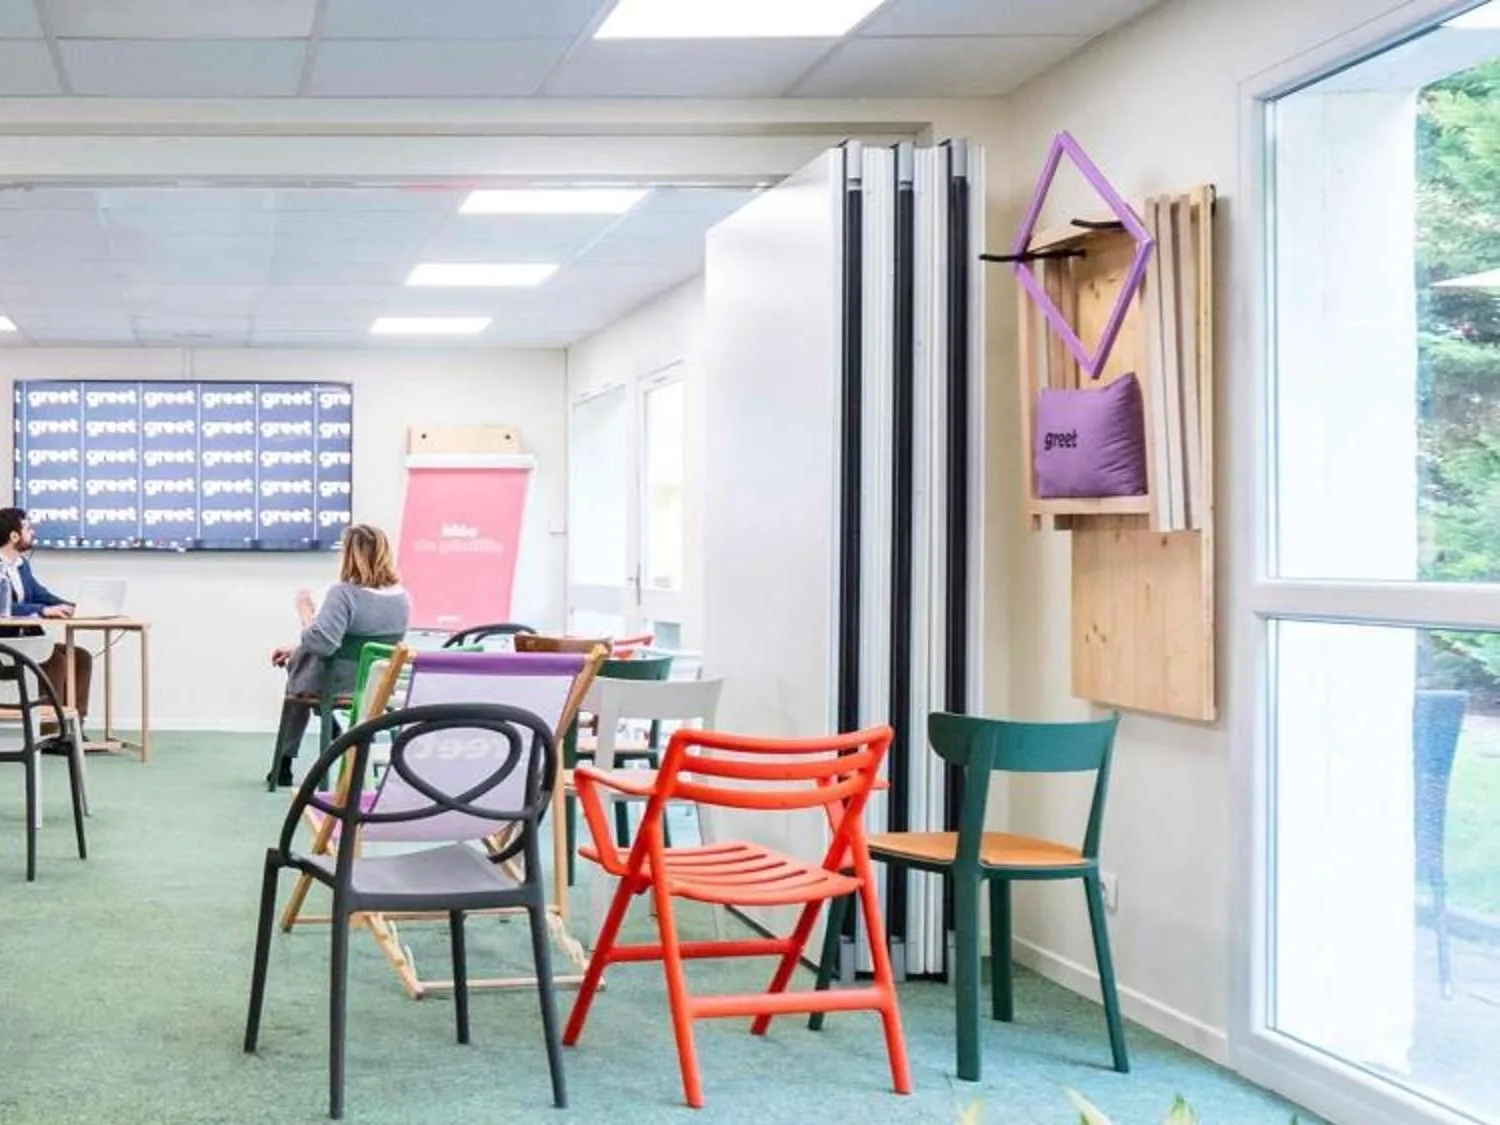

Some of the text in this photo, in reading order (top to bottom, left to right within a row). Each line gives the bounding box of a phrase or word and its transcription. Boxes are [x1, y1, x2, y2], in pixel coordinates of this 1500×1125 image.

[28, 389, 79, 408] greet
[85, 389, 138, 408] greet
[142, 390, 196, 409] greet
[201, 390, 255, 409] greet
[260, 391, 313, 409] greet
[28, 418, 79, 438] greet
[85, 418, 138, 438] greet
[142, 419, 196, 439] greet
[201, 419, 255, 439] greet
[260, 420, 313, 439] greet
[1044, 428, 1079, 450] greet
[28, 447, 79, 468] greet
[85, 447, 138, 468] greet
[142, 448, 196, 469] greet
[201, 448, 255, 469] greet
[260, 449, 313, 469] greet
[28, 476, 79, 497] greet
[85, 476, 138, 497] greet
[142, 477, 196, 498] greet
[201, 477, 255, 498] greet
[260, 478, 313, 498] greet
[28, 506, 79, 526] greet
[85, 506, 138, 526] greet
[142, 507, 196, 527] greet
[201, 507, 255, 527] greet
[260, 508, 313, 527] greet
